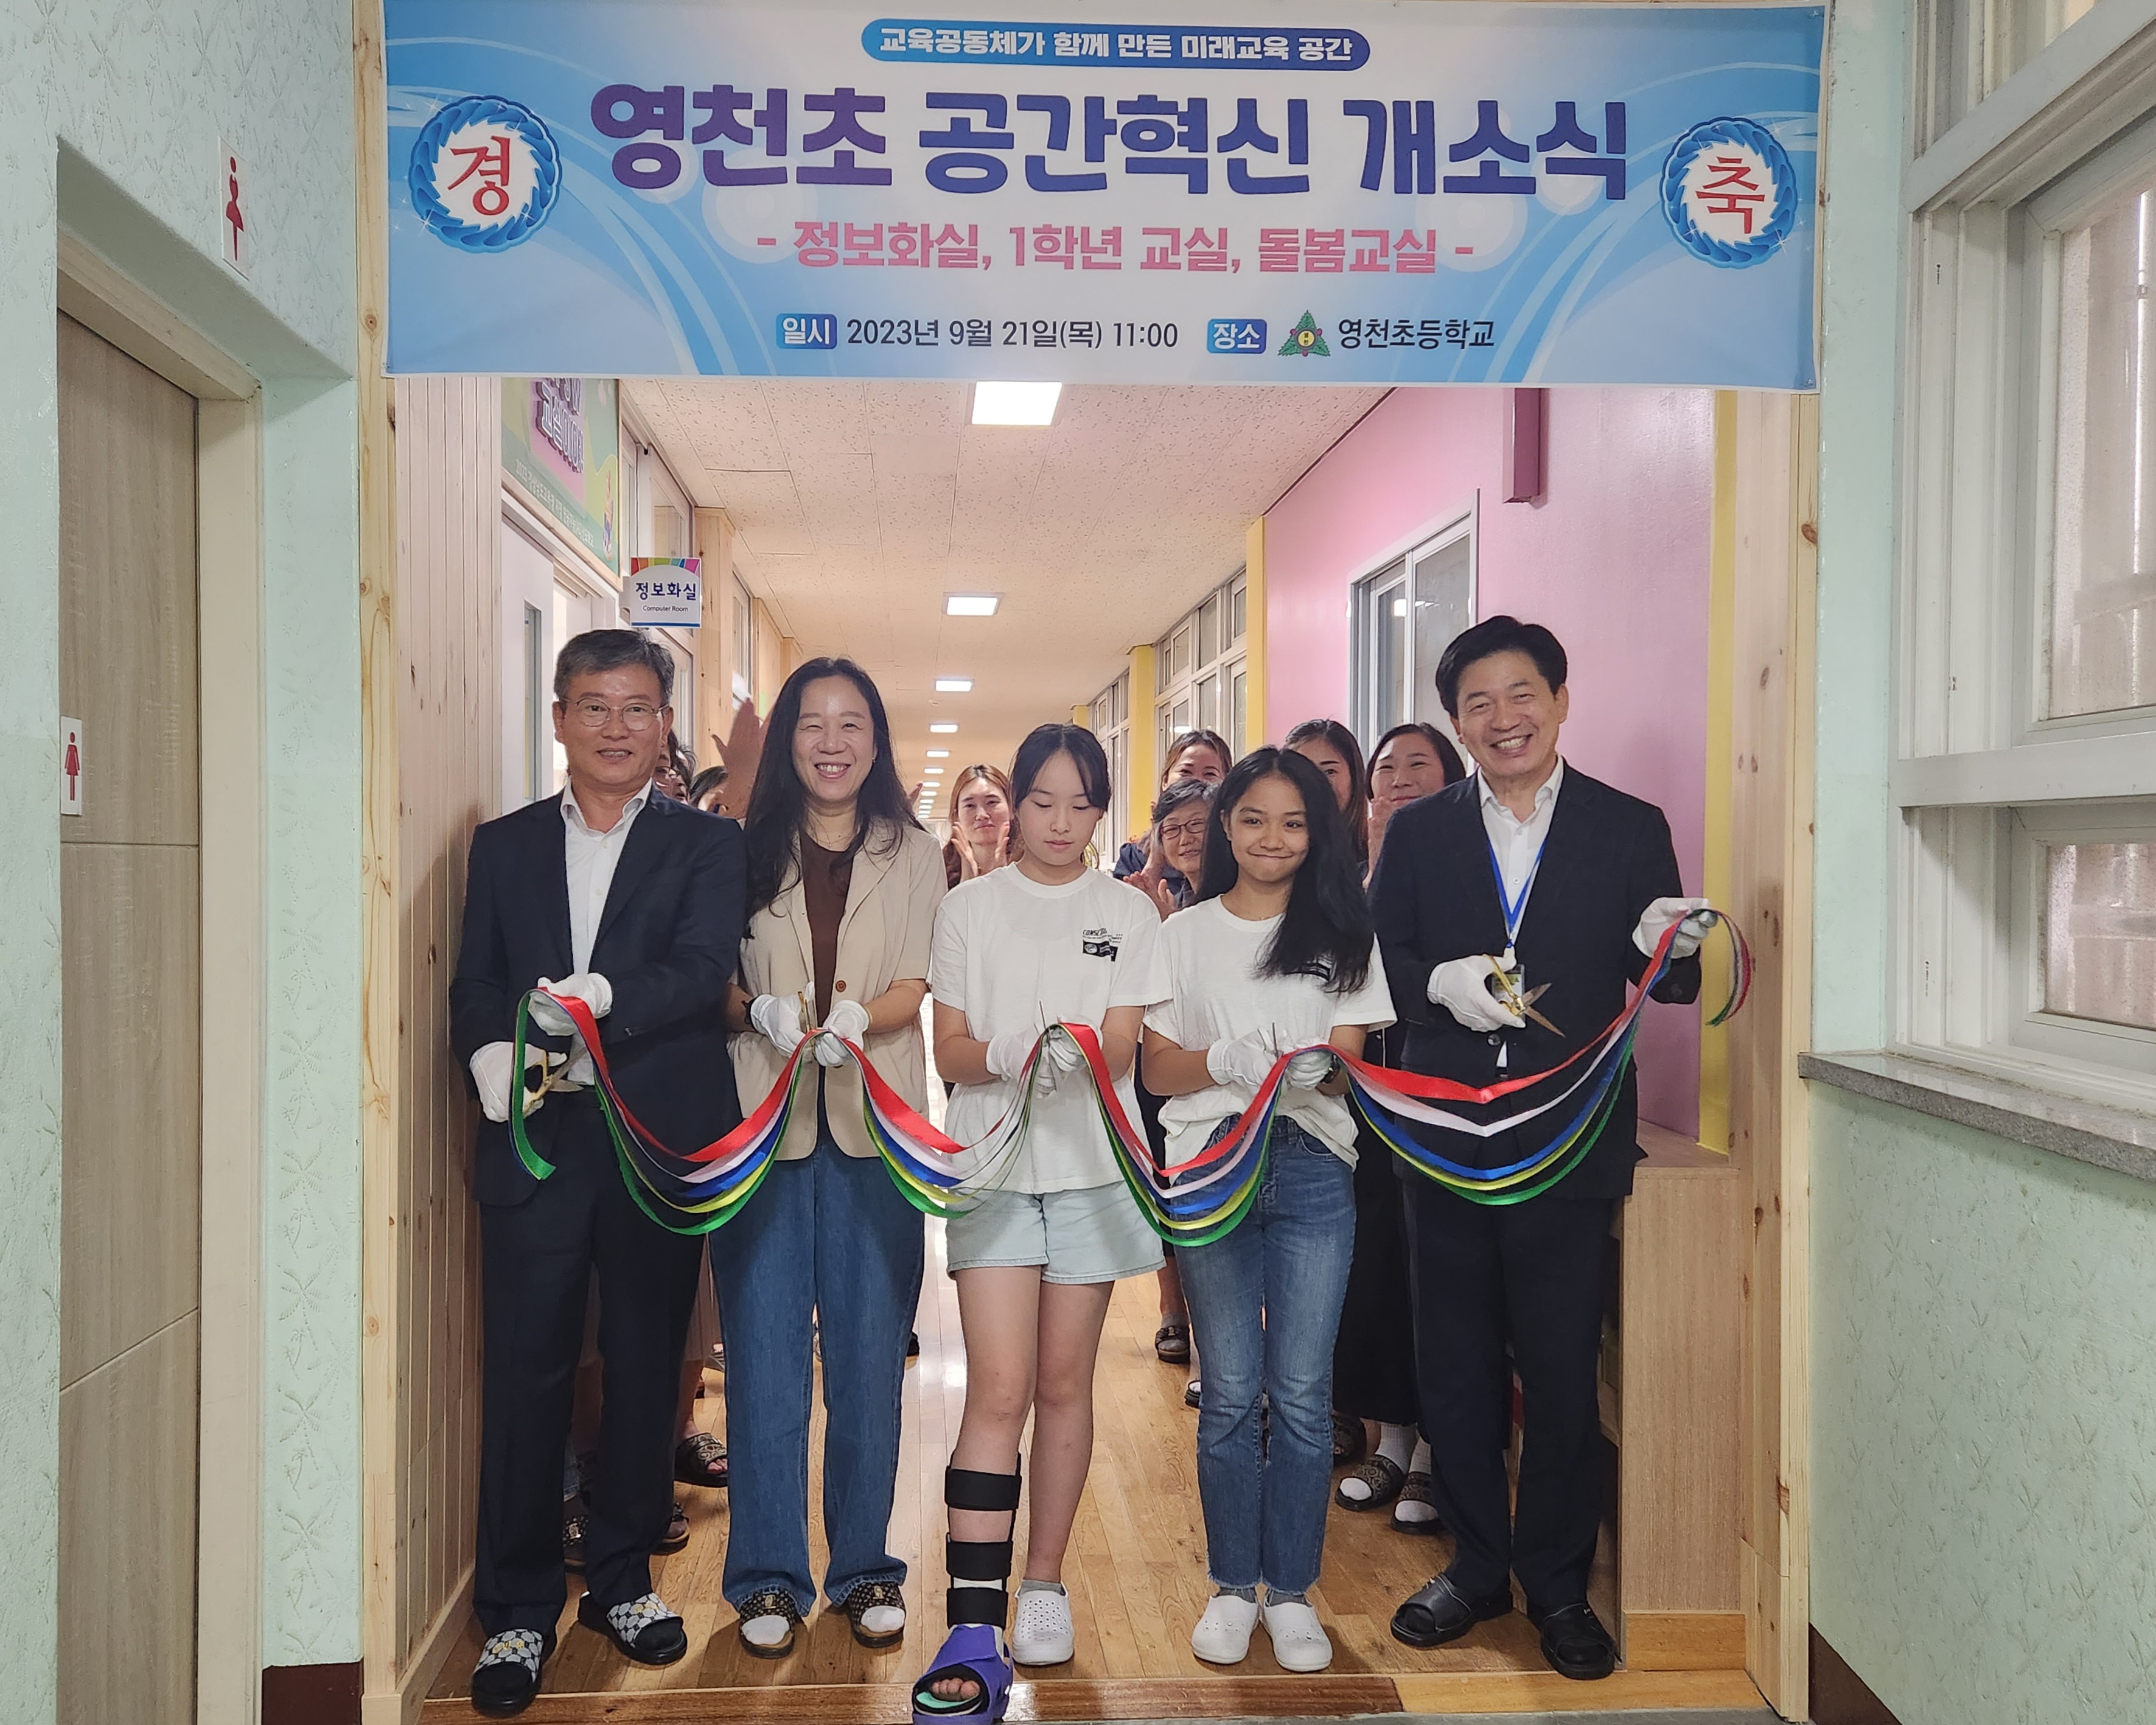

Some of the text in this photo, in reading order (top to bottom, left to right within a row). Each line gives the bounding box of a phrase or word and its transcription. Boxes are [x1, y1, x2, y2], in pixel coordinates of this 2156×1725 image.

[879, 28, 1353, 61] 교육공동체가 함께 만든 미래교육 공간
[590, 84, 1627, 200] 영천초 공간혁신 개소식
[447, 135, 511, 216] 경
[1695, 155, 1765, 234] 축
[794, 221, 993, 271] 정보화실,
[1009, 224, 1123, 271] 1학년
[1140, 227, 1241, 274] 교실,
[1257, 228, 1436, 274] 돌봄교실
[782, 317, 831, 346] 일시
[846, 319, 1179, 350] 2023년 9월 21일(목) 11:00
[1212, 323, 1261, 350] 장소
[1338, 318, 1495, 349] 영천초등학교
[635, 582, 696, 601] 정보화실
